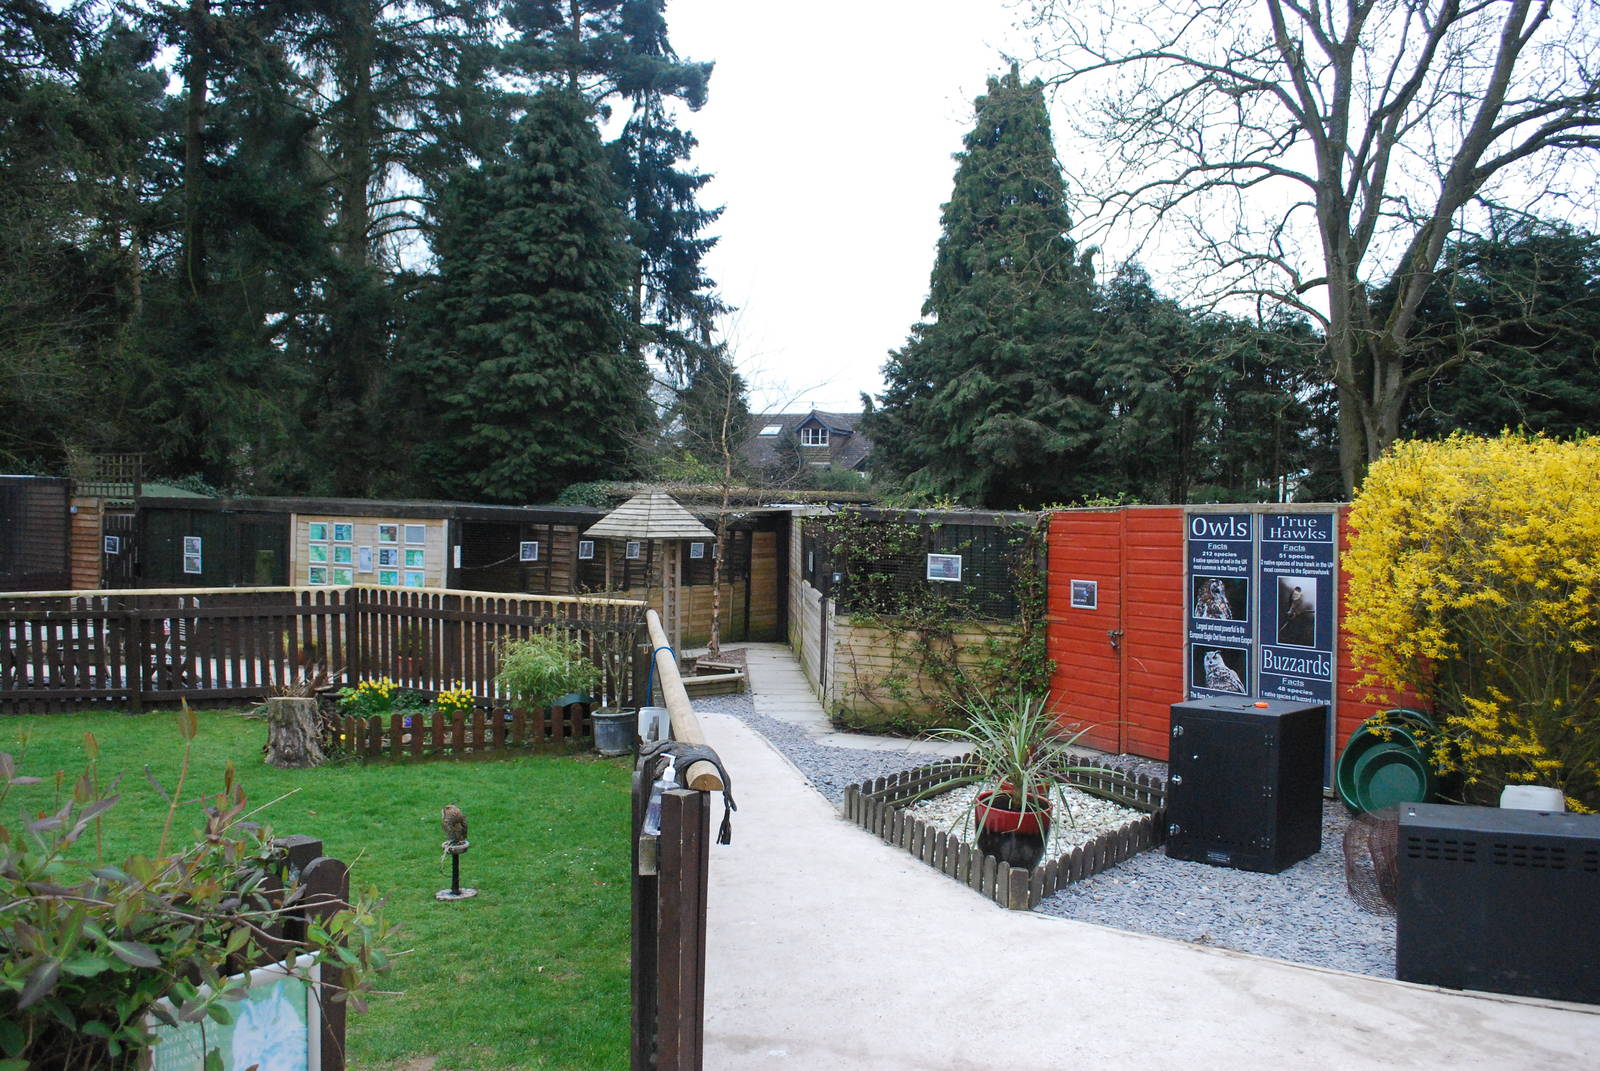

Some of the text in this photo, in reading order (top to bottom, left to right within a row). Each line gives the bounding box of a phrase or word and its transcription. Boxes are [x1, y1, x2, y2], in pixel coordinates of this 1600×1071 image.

[1192, 517, 1247, 536] Owls
[1277, 516, 1317, 527] True
[1271, 528, 1326, 539] Hawks
[1283, 544, 1305, 552] Facts
[1263, 650, 1329, 676] Buzzards
[1282, 677, 1305, 687] Facts
[1287, 688, 1313, 696] species
